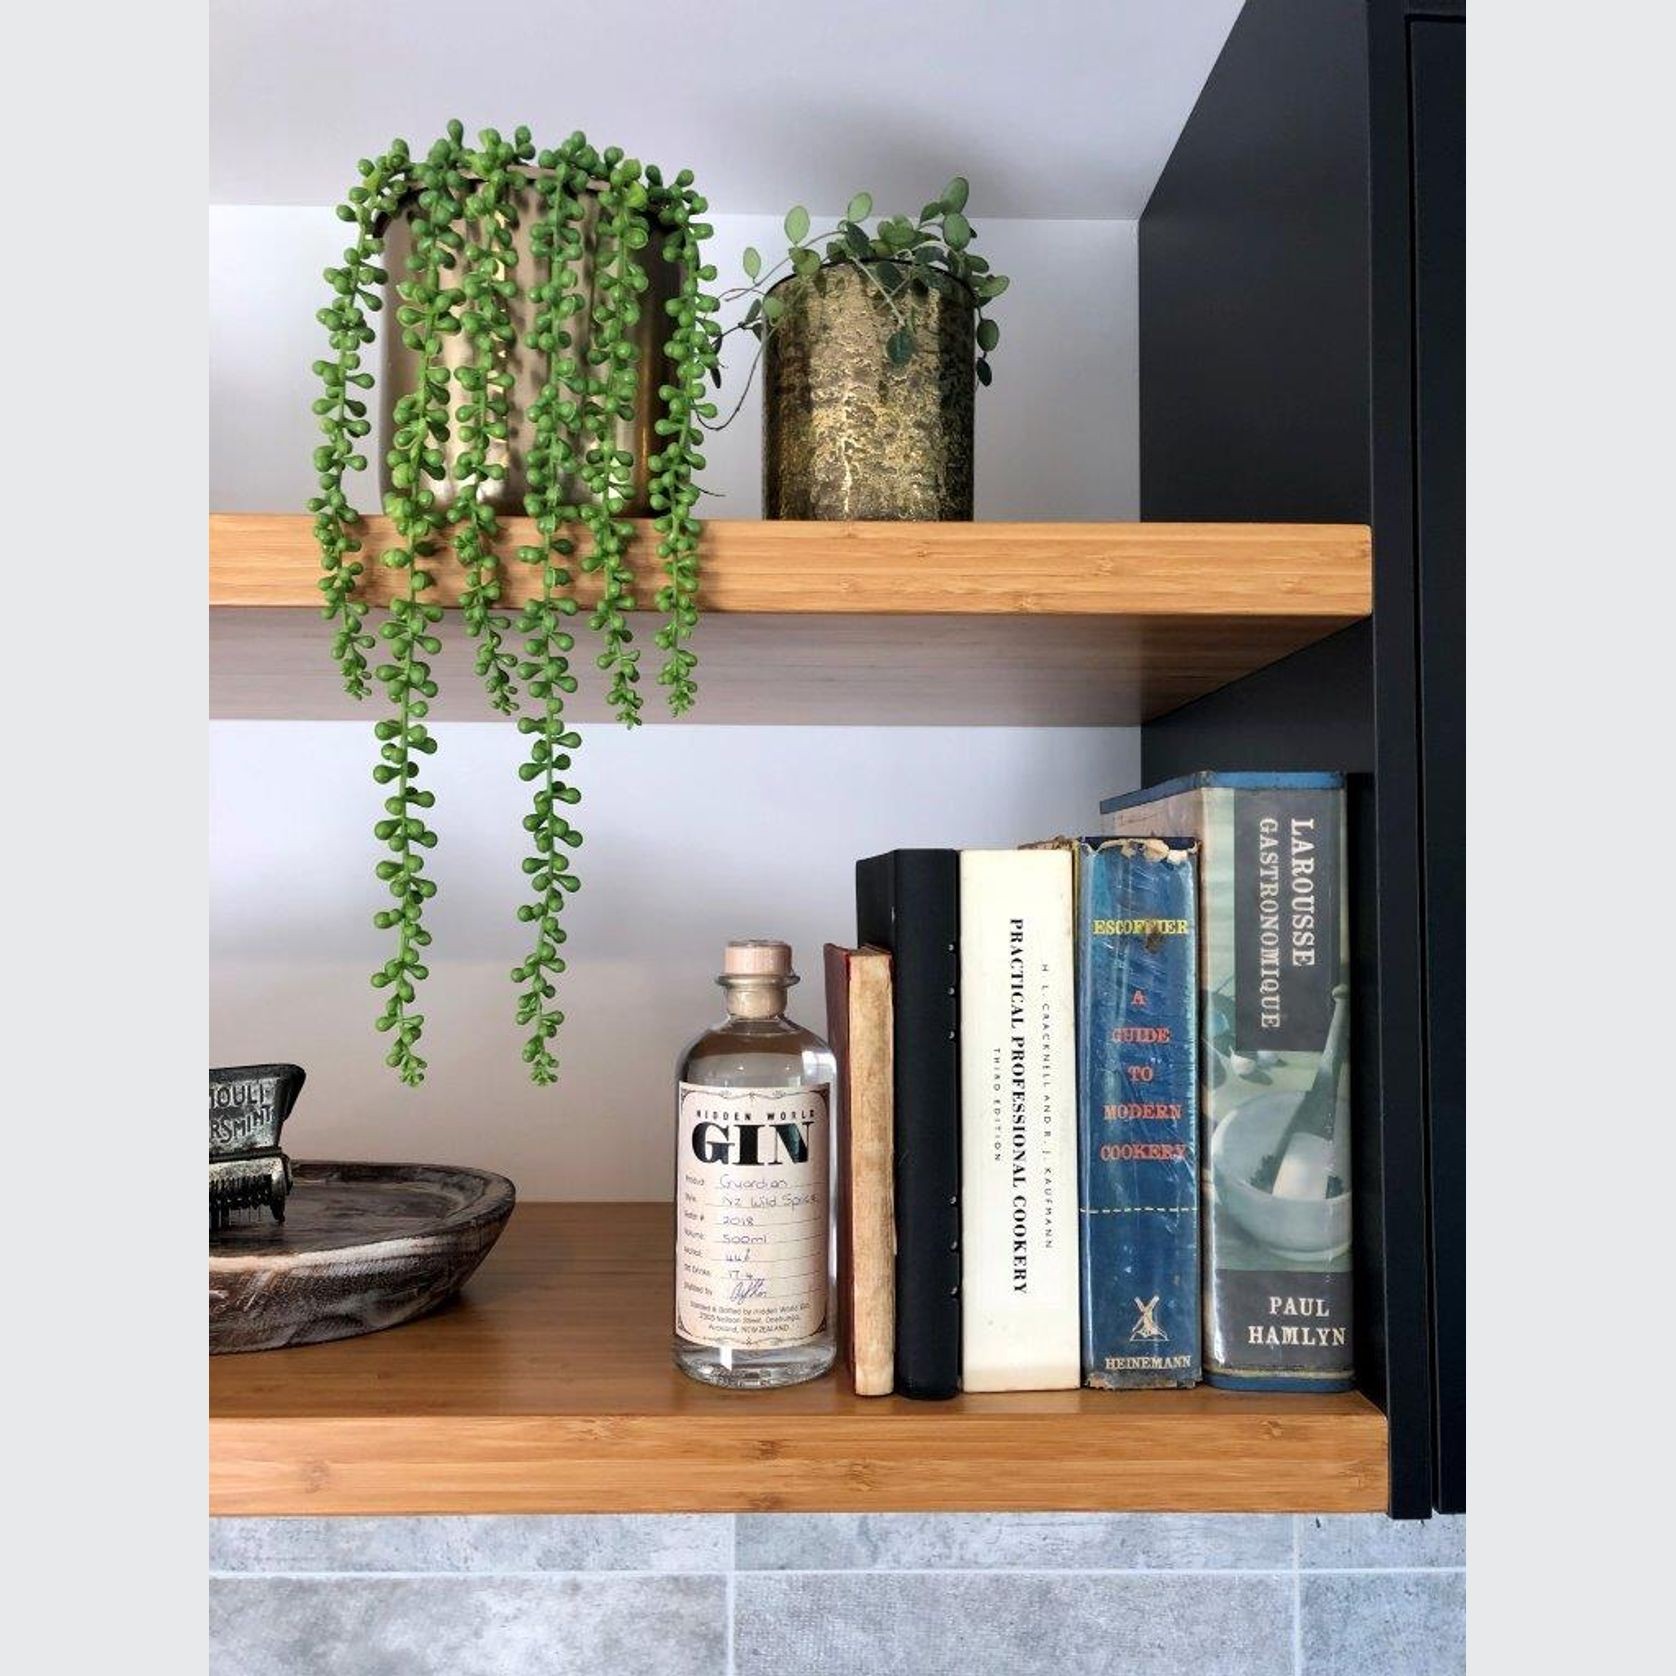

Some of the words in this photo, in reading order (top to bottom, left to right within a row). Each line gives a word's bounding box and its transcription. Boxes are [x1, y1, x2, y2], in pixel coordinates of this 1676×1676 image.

[1291, 818, 1316, 967] LAROUSSE
[1093, 918, 1190, 936] ESCOFFIER
[1259, 817, 1281, 1029] GASTRONOMIQUE
[1010, 918, 1024, 1030] PRACTICAL
[1131, 991, 1146, 1006] A
[1042, 1003, 1051, 1088] CRACKNELL
[1111, 1027, 1171, 1045] GUIDE
[993, 1048, 1001, 1092] THIRD
[1128, 1066, 1154, 1083] TO
[1011, 1036, 1026, 1188] PROFESSIONAL
[1043, 1095, 1051, 1124] AND
[1103, 1103, 1182, 1121] MODERN
[691, 1121, 815, 1166] GIN
[993, 1099, 1002, 1162] EDITION
[1100, 1143, 1188, 1162] COOKERY
[722, 1216, 754, 1226] 2018
[1044, 1167, 1053, 1250] KAUFMANN
[722, 1234, 767, 1245] 500ml
[1012, 1195, 1028, 1295] COOKERY
[1268, 1296, 1330, 1318] PAUL
[1248, 1324, 1347, 1347] HAMLYN
[1105, 1354, 1191, 1370] HEINEMANN
